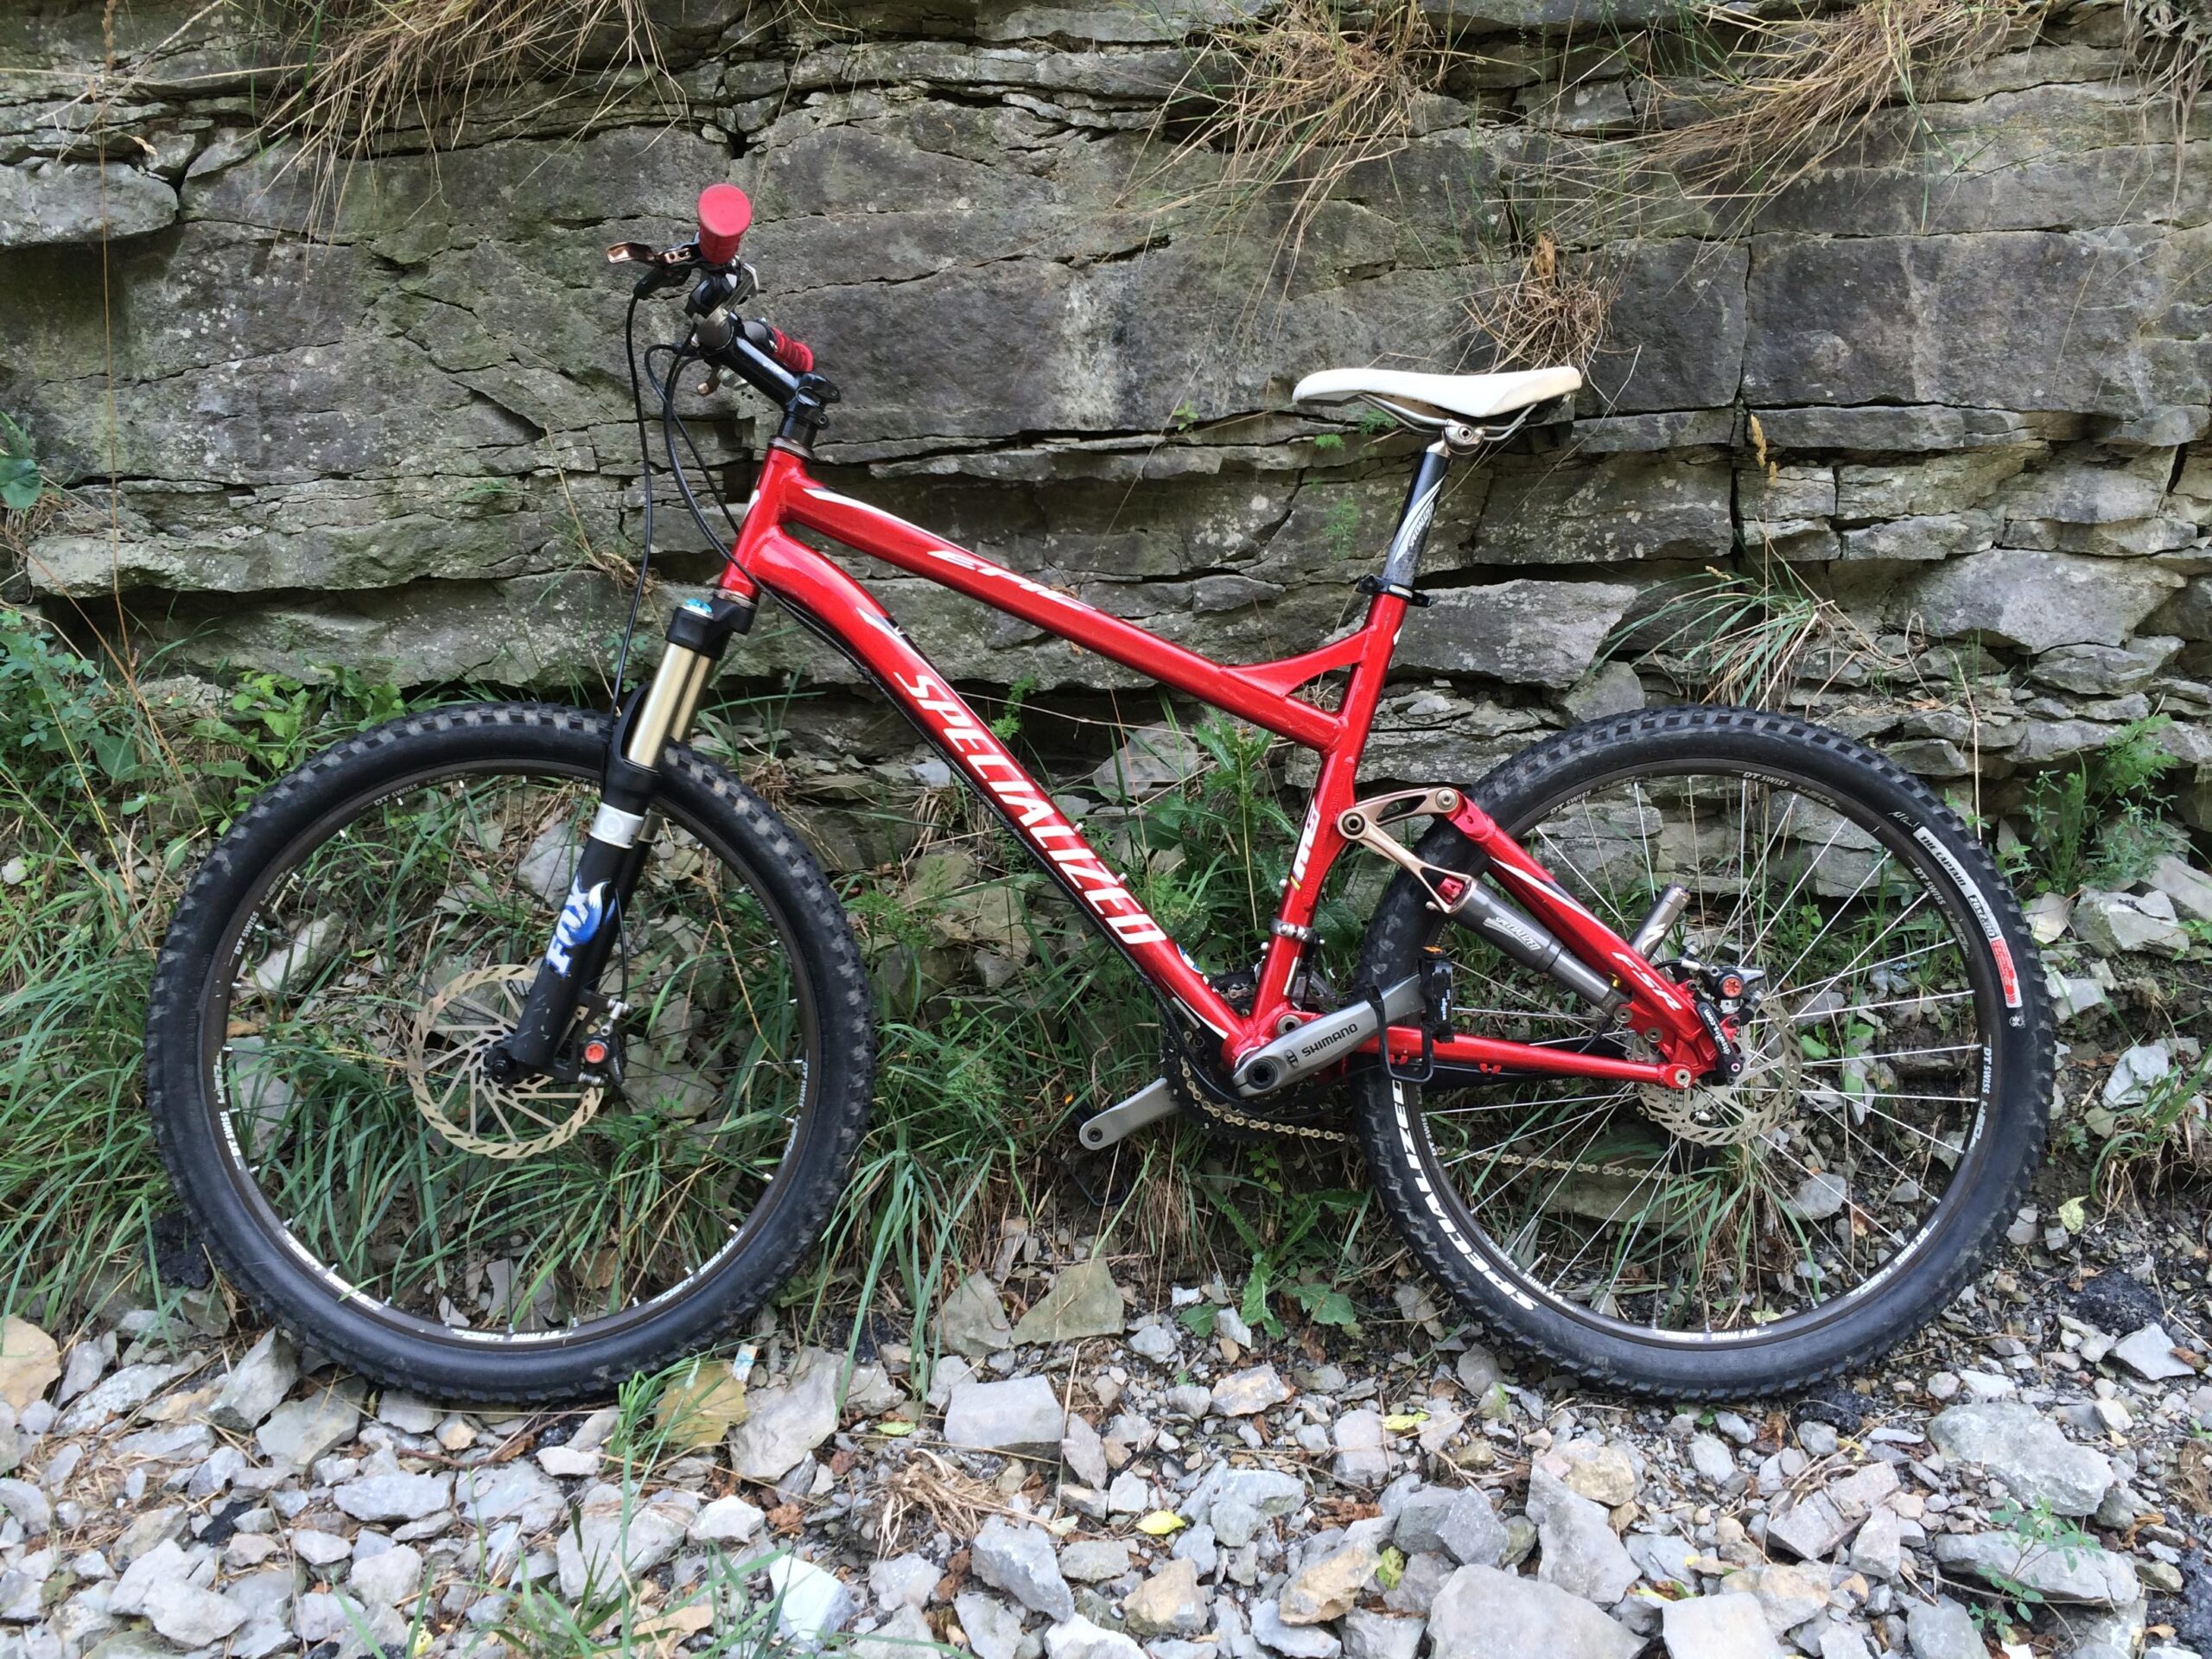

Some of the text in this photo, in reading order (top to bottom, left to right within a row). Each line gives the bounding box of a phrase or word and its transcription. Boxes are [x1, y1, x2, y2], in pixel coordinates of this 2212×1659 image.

[1743, 770, 1760, 779] DT
[1759, 773, 1789, 787] SWISS
[893, 671, 1166, 944] SPECIALIZED
[1919, 834, 1936, 851] THE
[1936, 851, 1966, 887] CAPTAIN
[234, 938, 246, 955] DT
[241, 911, 259, 938] SWISS
[544, 869, 602, 978] FOX
[1494, 916, 1541, 950] SPECIALIZED
[1611, 950, 1682, 1012] FSR
[1301, 1023, 1359, 1058] SHIMANO
[1983, 1047, 1992, 1065] DT
[1982, 1065, 1992, 1094] SWISS
[219, 1109, 235, 1139] SWISS
[1420, 1112, 1438, 1156] DT SWISS
[226, 1137, 241, 1157] DT
[1392, 1079, 1539, 1311] SPECIALIZED
[1894, 1241, 1918, 1266] SWISS
[1916, 1228, 1929, 1245] DT
